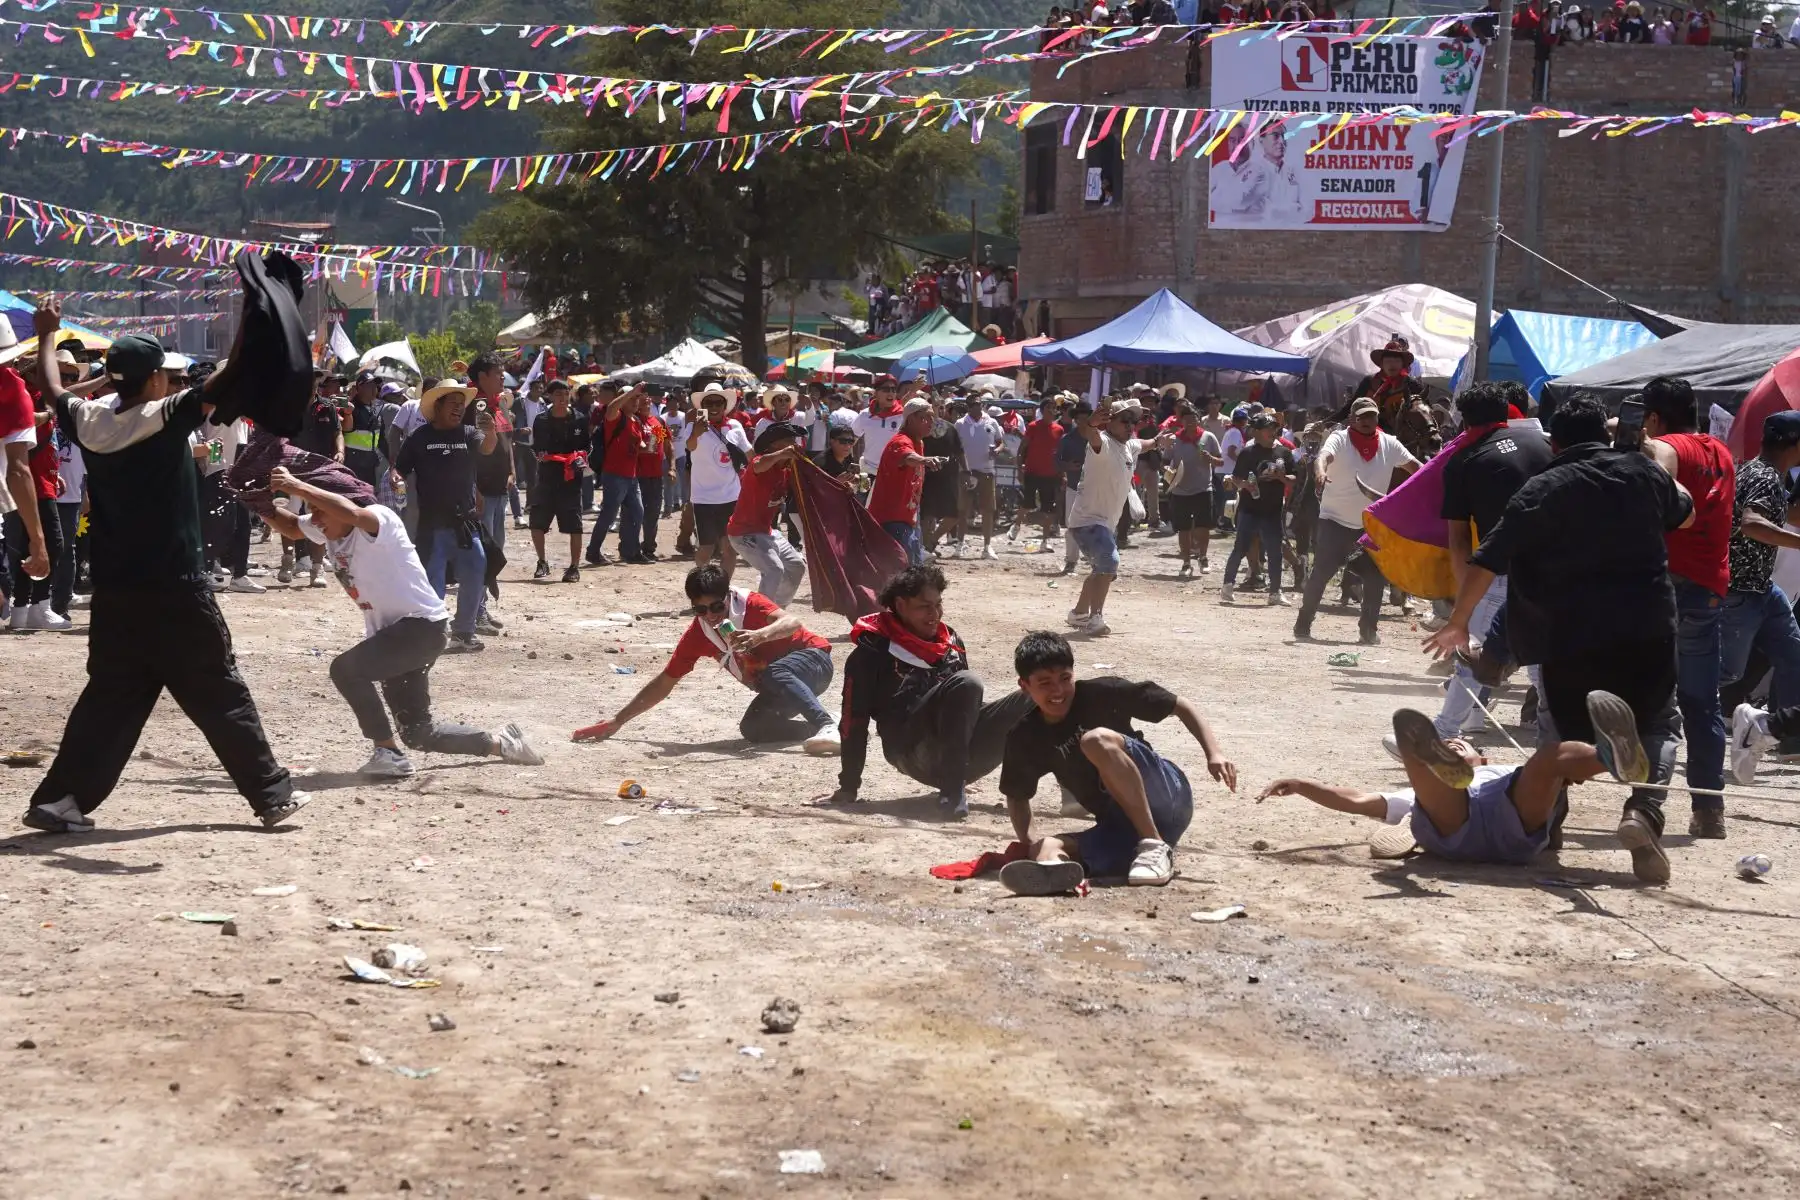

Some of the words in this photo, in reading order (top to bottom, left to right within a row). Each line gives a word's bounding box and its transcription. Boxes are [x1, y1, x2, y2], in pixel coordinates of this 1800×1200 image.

[1296, 45, 1313, 83] 1
[1331, 39, 1418, 73] PERÚ
[1331, 72, 1418, 94] PRIMERO
[1243, 99, 1321, 113] VIZCARRA
[1429, 103, 1461, 116] 2026
[1310, 124, 1411, 151] JOHNY
[1304, 154, 1413, 170] BARRIENTOS
[1321, 178, 1395, 193] SENADOR
[1417, 162, 1432, 213] 1
[1321, 203, 1404, 218] REGIONAL
